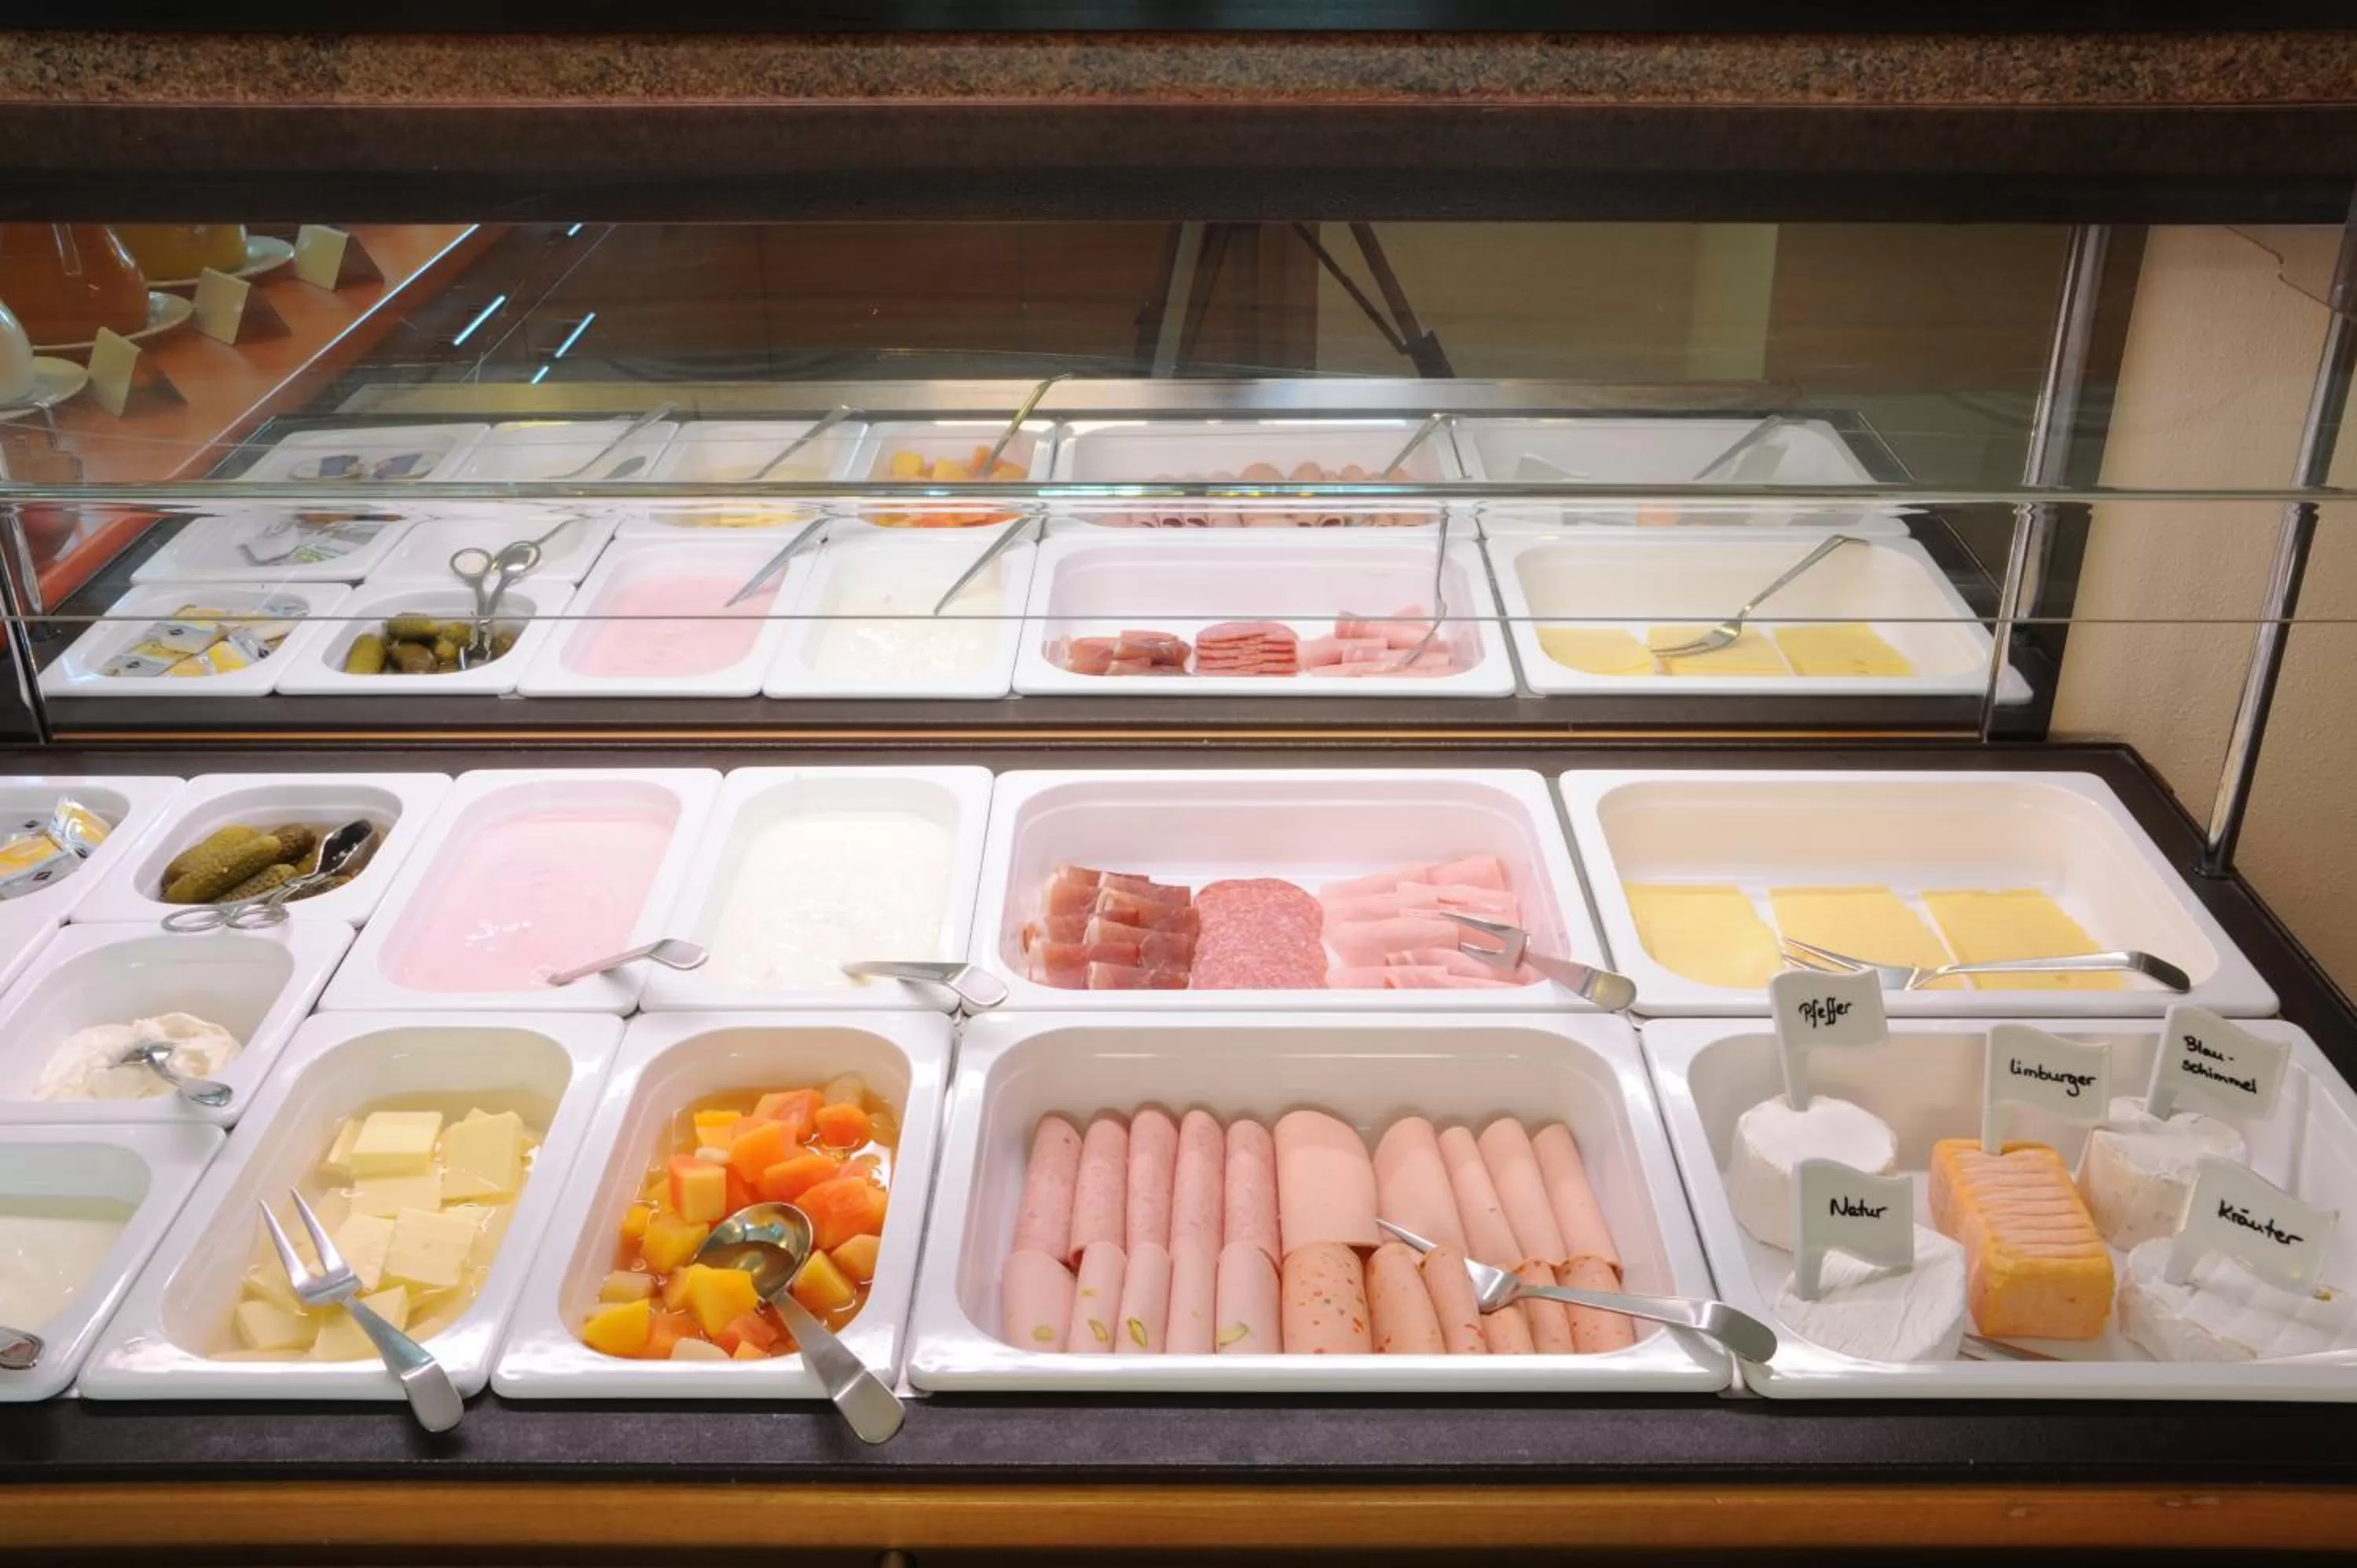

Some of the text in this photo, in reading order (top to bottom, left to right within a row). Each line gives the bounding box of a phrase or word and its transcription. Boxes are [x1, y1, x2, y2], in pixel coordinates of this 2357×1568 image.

[1798, 996, 1853, 1029] Pfeffer
[1829, 1195, 1889, 1220] Natur
[2217, 1198, 2304, 1245] Kräuter
